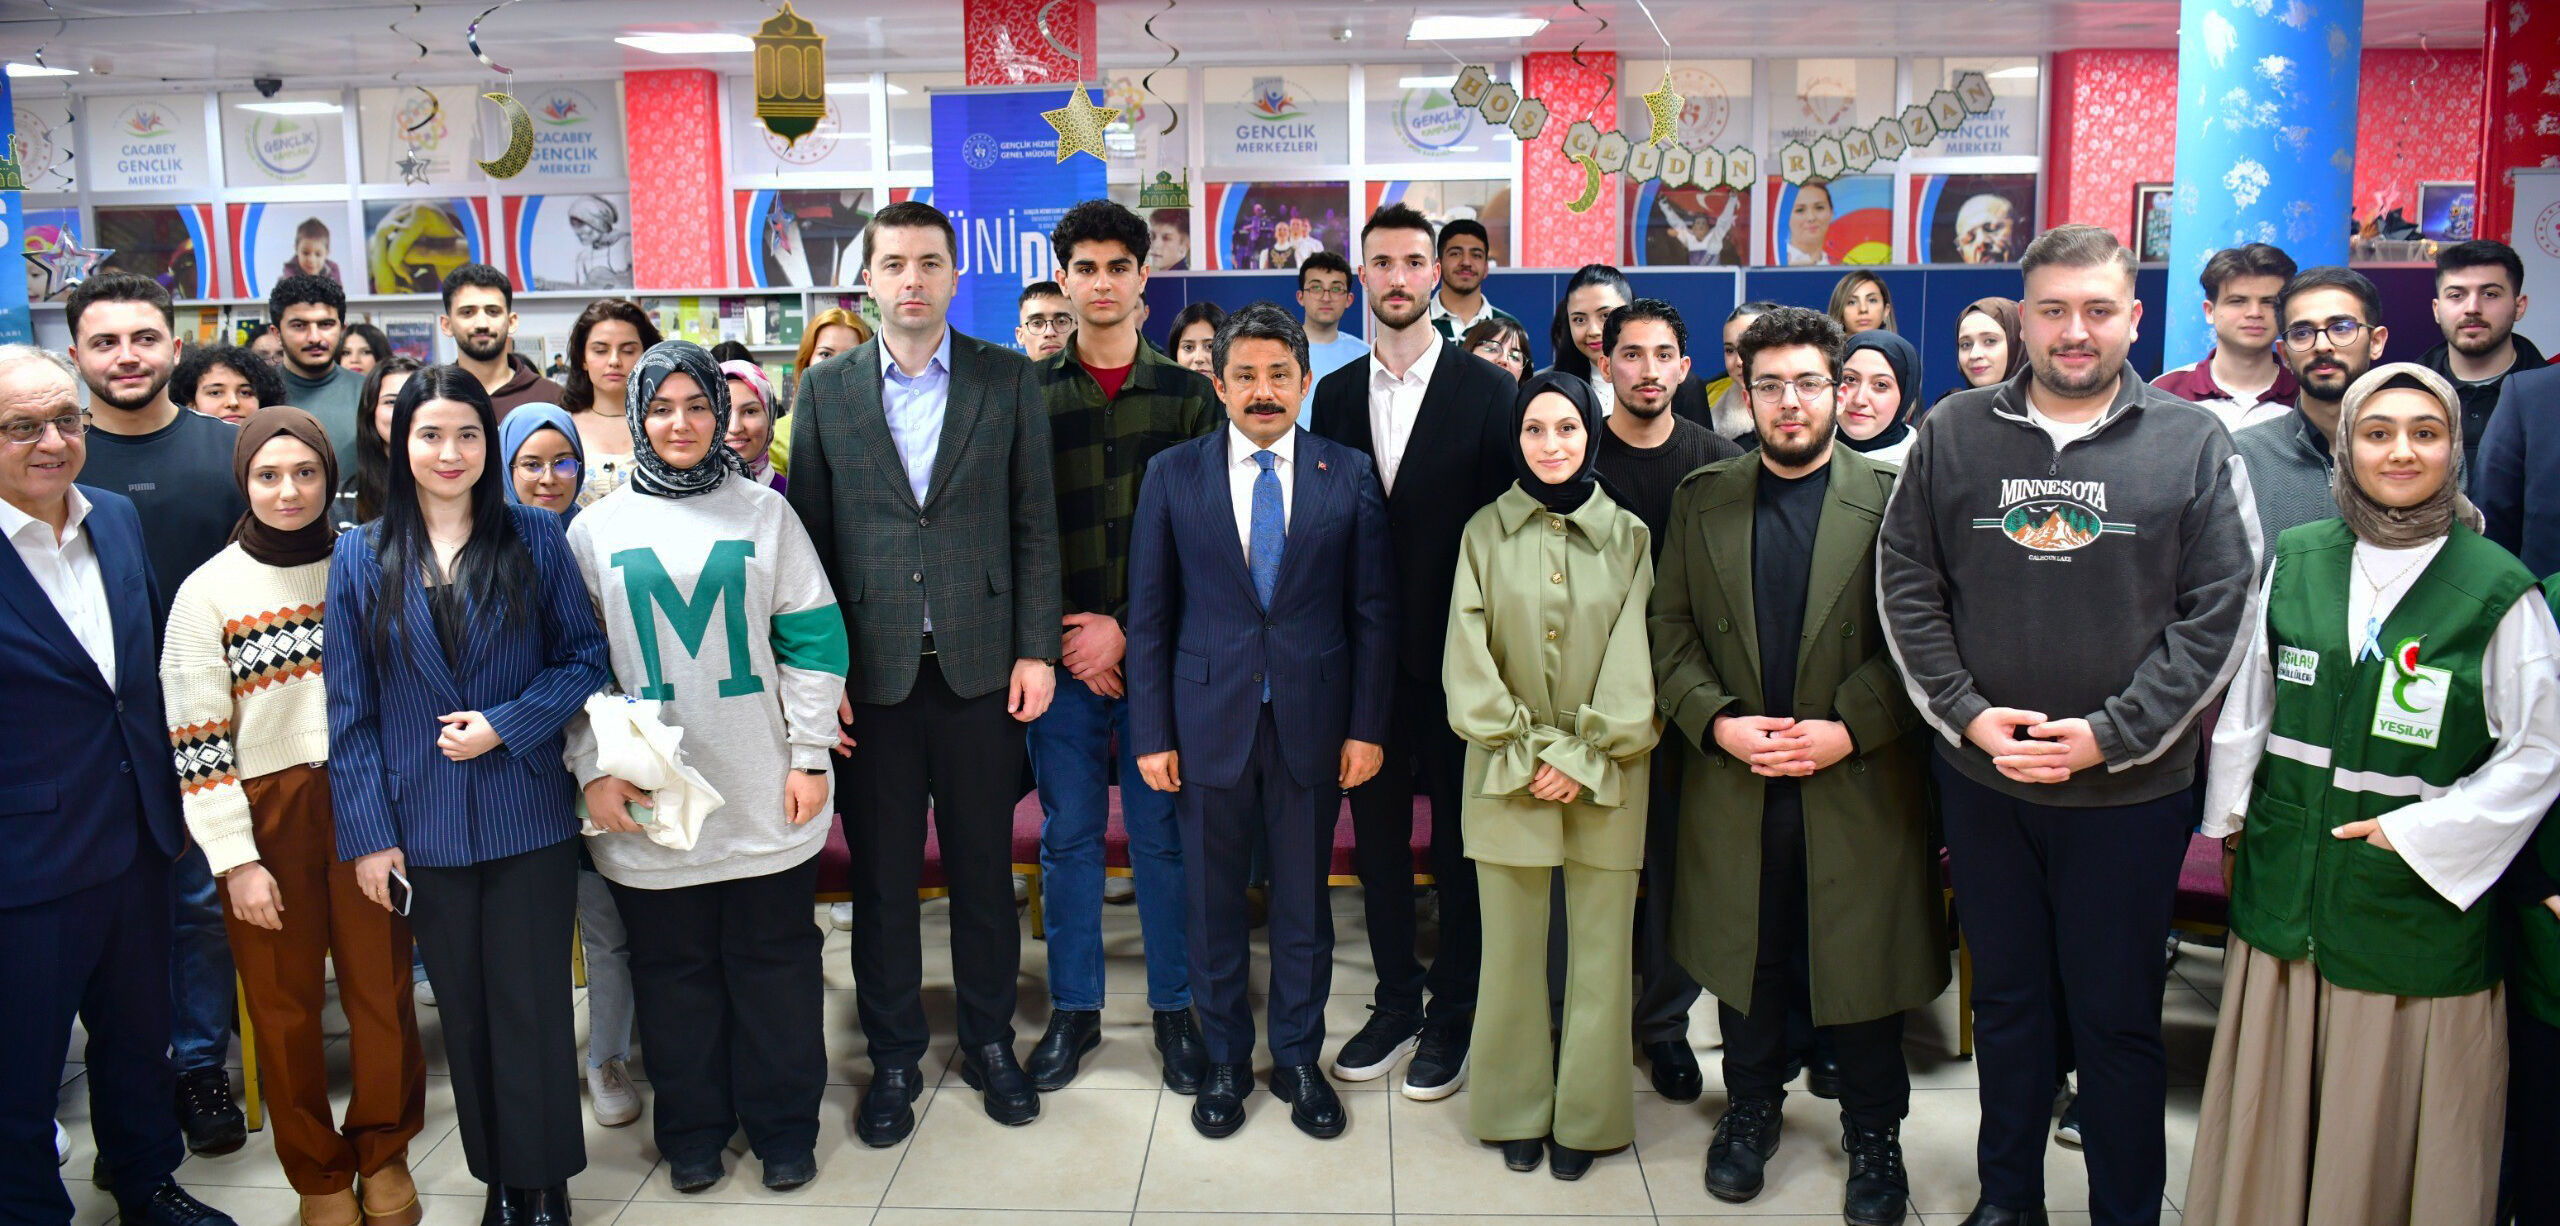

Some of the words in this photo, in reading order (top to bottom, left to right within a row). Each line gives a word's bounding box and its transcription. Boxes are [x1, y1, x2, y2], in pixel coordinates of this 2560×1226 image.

[1237, 123, 1316, 140] GENÇLİK
[1461, 75, 1537, 131] HOŞ
[1572, 133, 1749, 177] GELDİN
[1789, 83, 1986, 172] RAMAZAN
[534, 131, 592, 143] CACABEY
[122, 143, 177, 156] CACABEY
[1001, 151, 1024, 159] GENEL
[118, 158, 182, 173] GENÇLİK
[128, 482, 156, 492] PUMA
[1998, 479, 2108, 512] MINNESOTA
[611, 540, 765, 702] M
